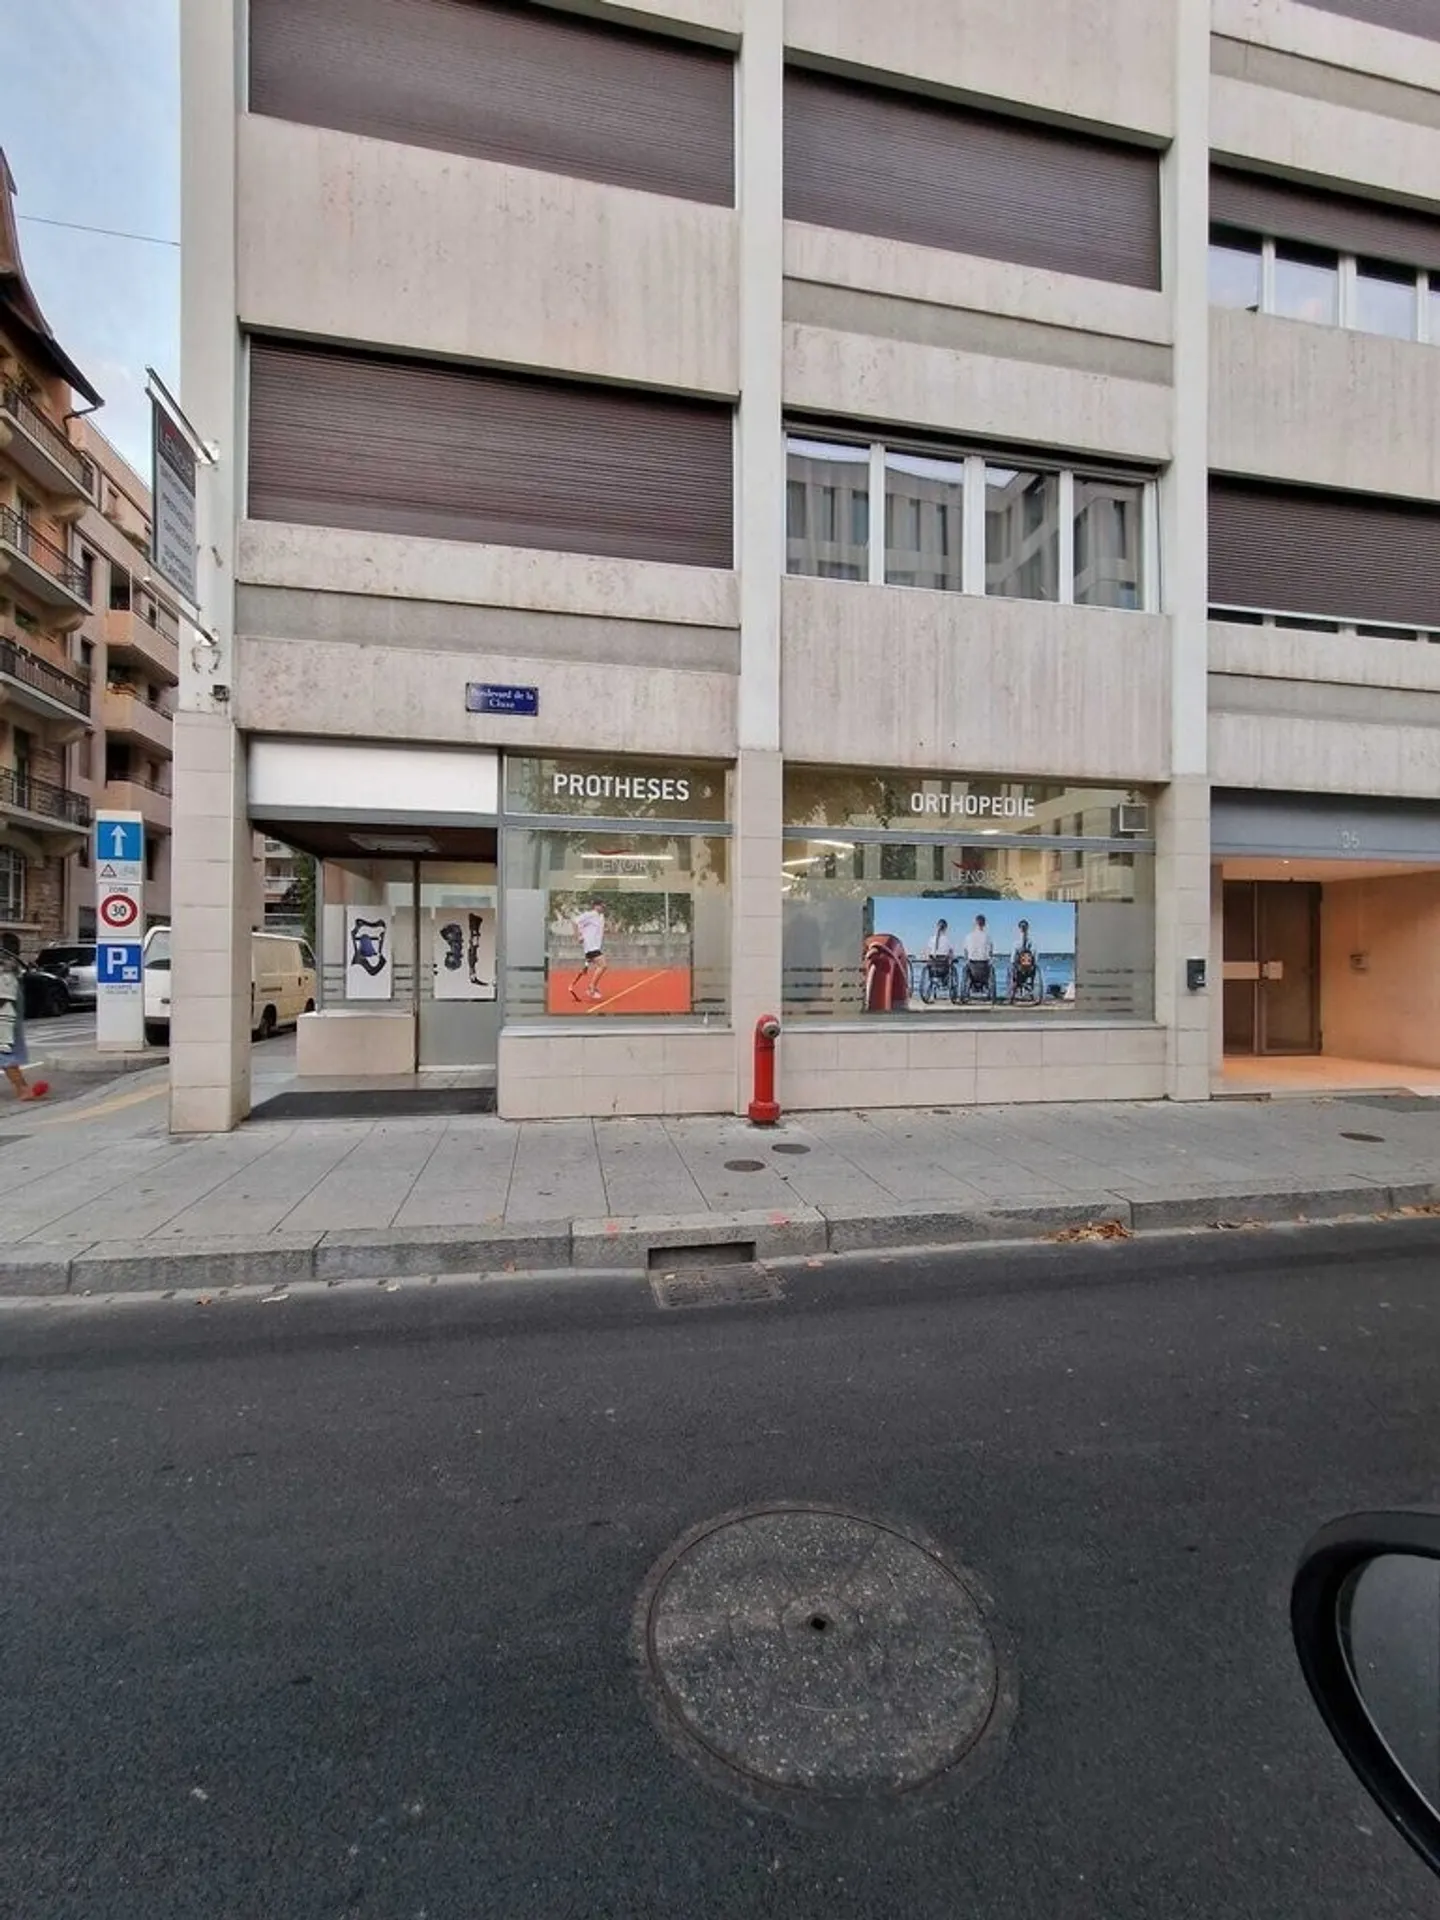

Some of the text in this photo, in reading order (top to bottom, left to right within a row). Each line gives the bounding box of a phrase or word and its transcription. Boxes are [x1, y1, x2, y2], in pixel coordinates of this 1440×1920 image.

[553, 773, 690, 801] PROTHESES
[911, 792, 1036, 817] ORTHOPEDIE
[110, 903, 127, 917] 30
[107, 947, 128, 975] P
